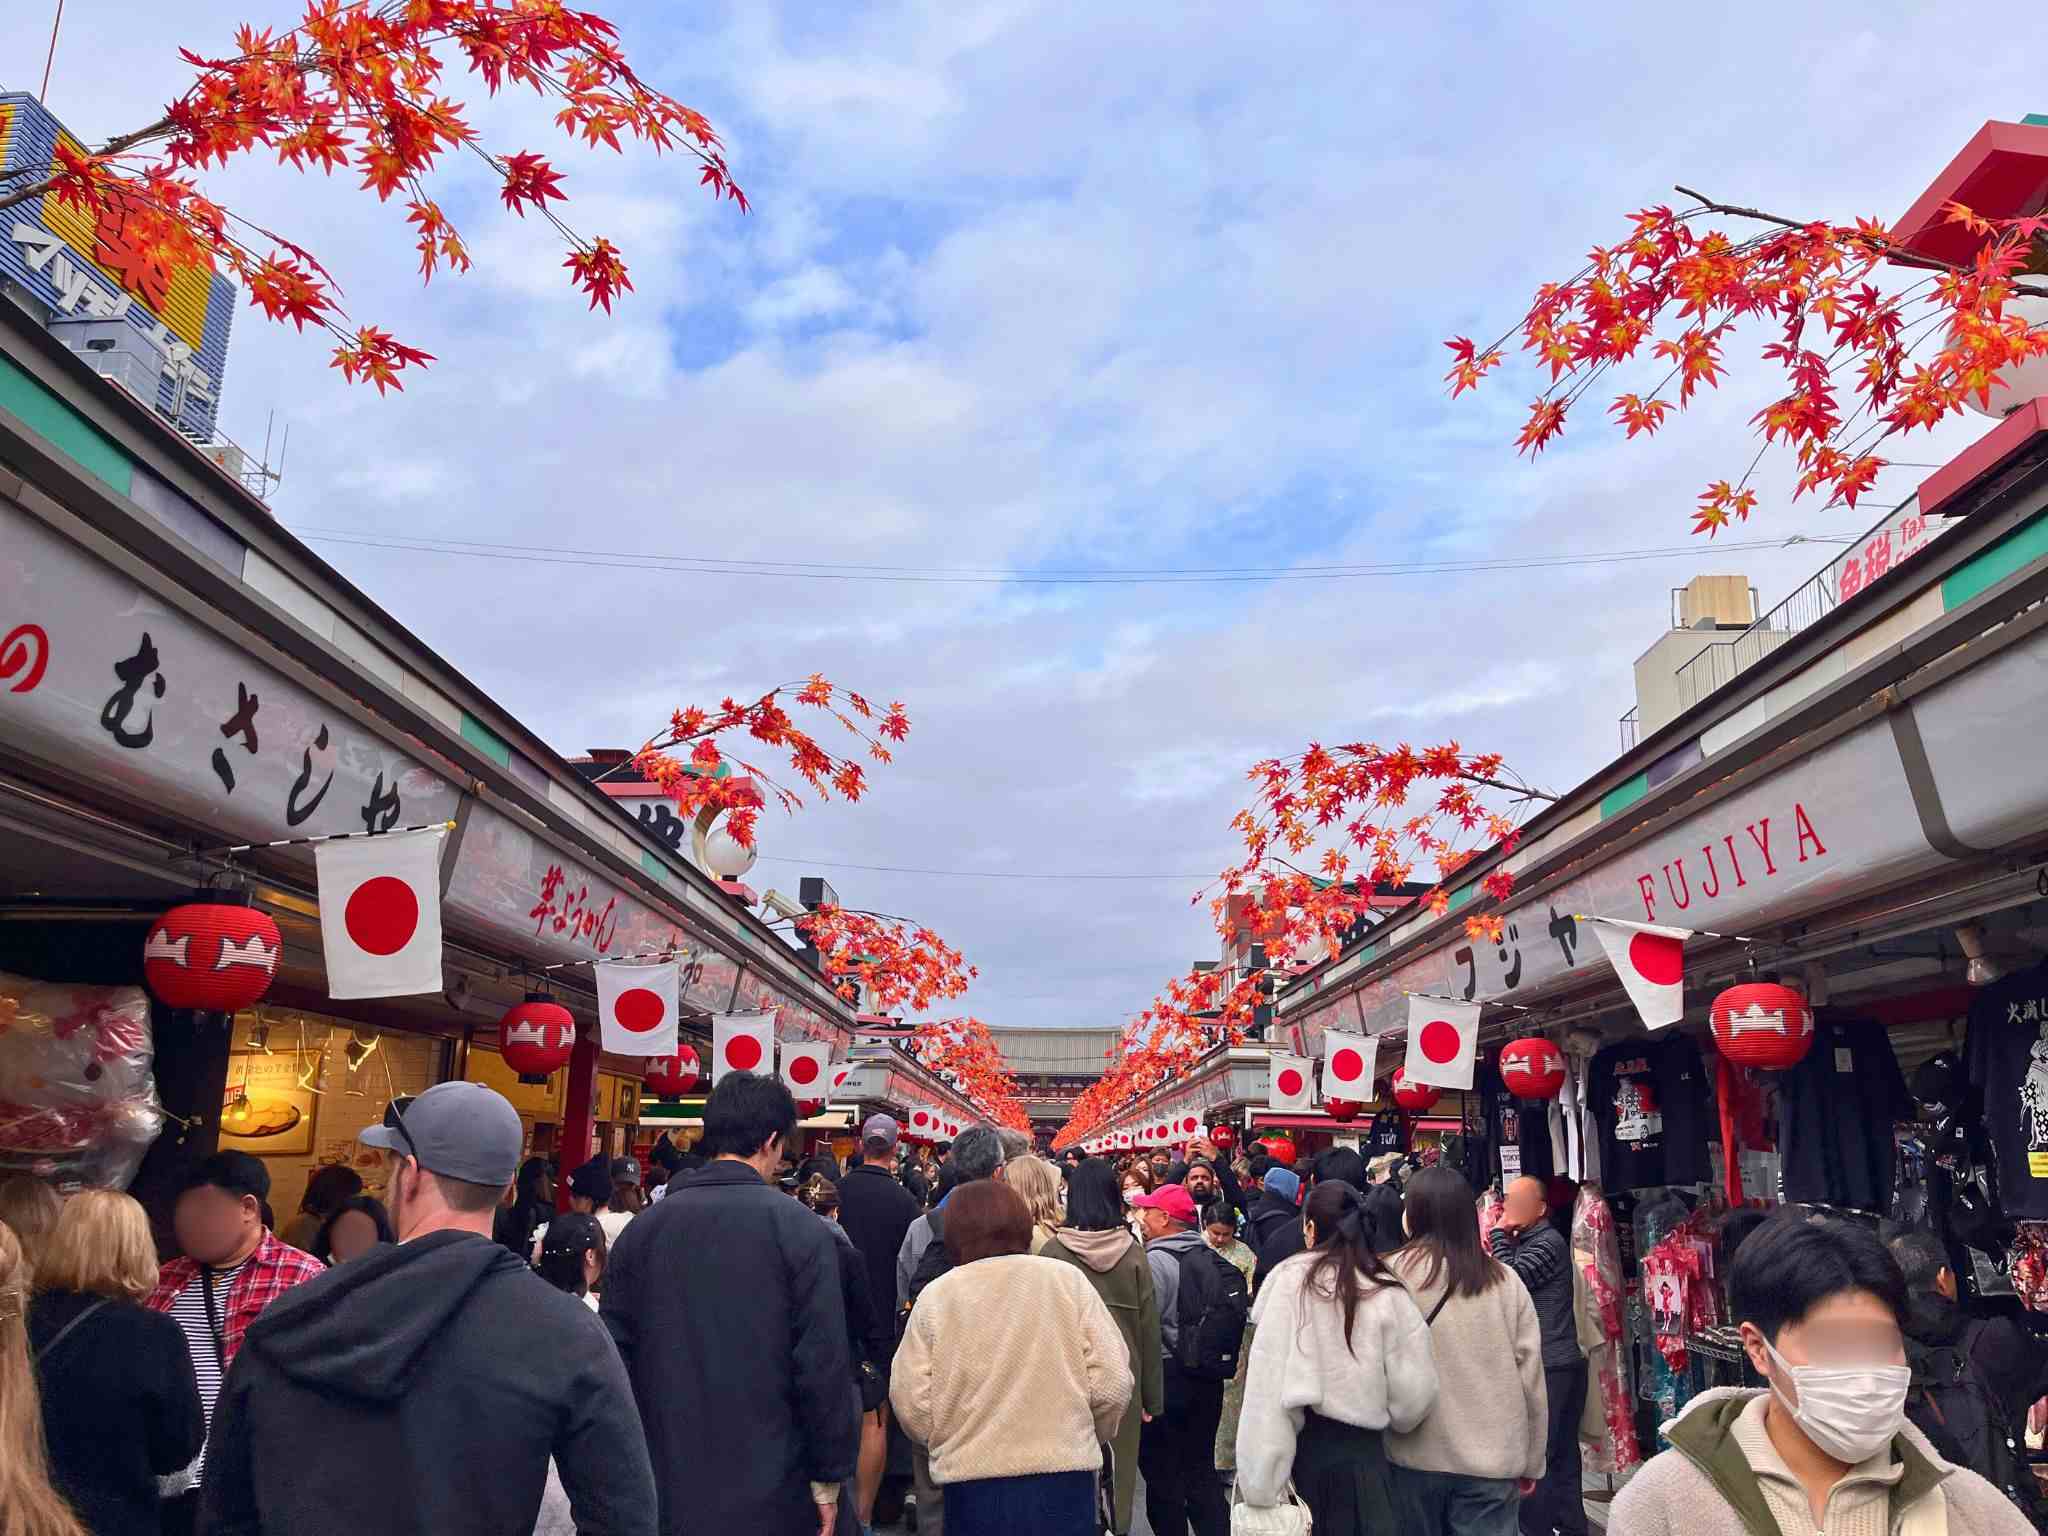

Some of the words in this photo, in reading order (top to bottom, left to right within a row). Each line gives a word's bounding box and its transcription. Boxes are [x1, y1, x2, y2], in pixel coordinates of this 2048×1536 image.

[1455, 906, 1577, 1000] フジヤ
[1637, 803, 1827, 922] FUJIYA
